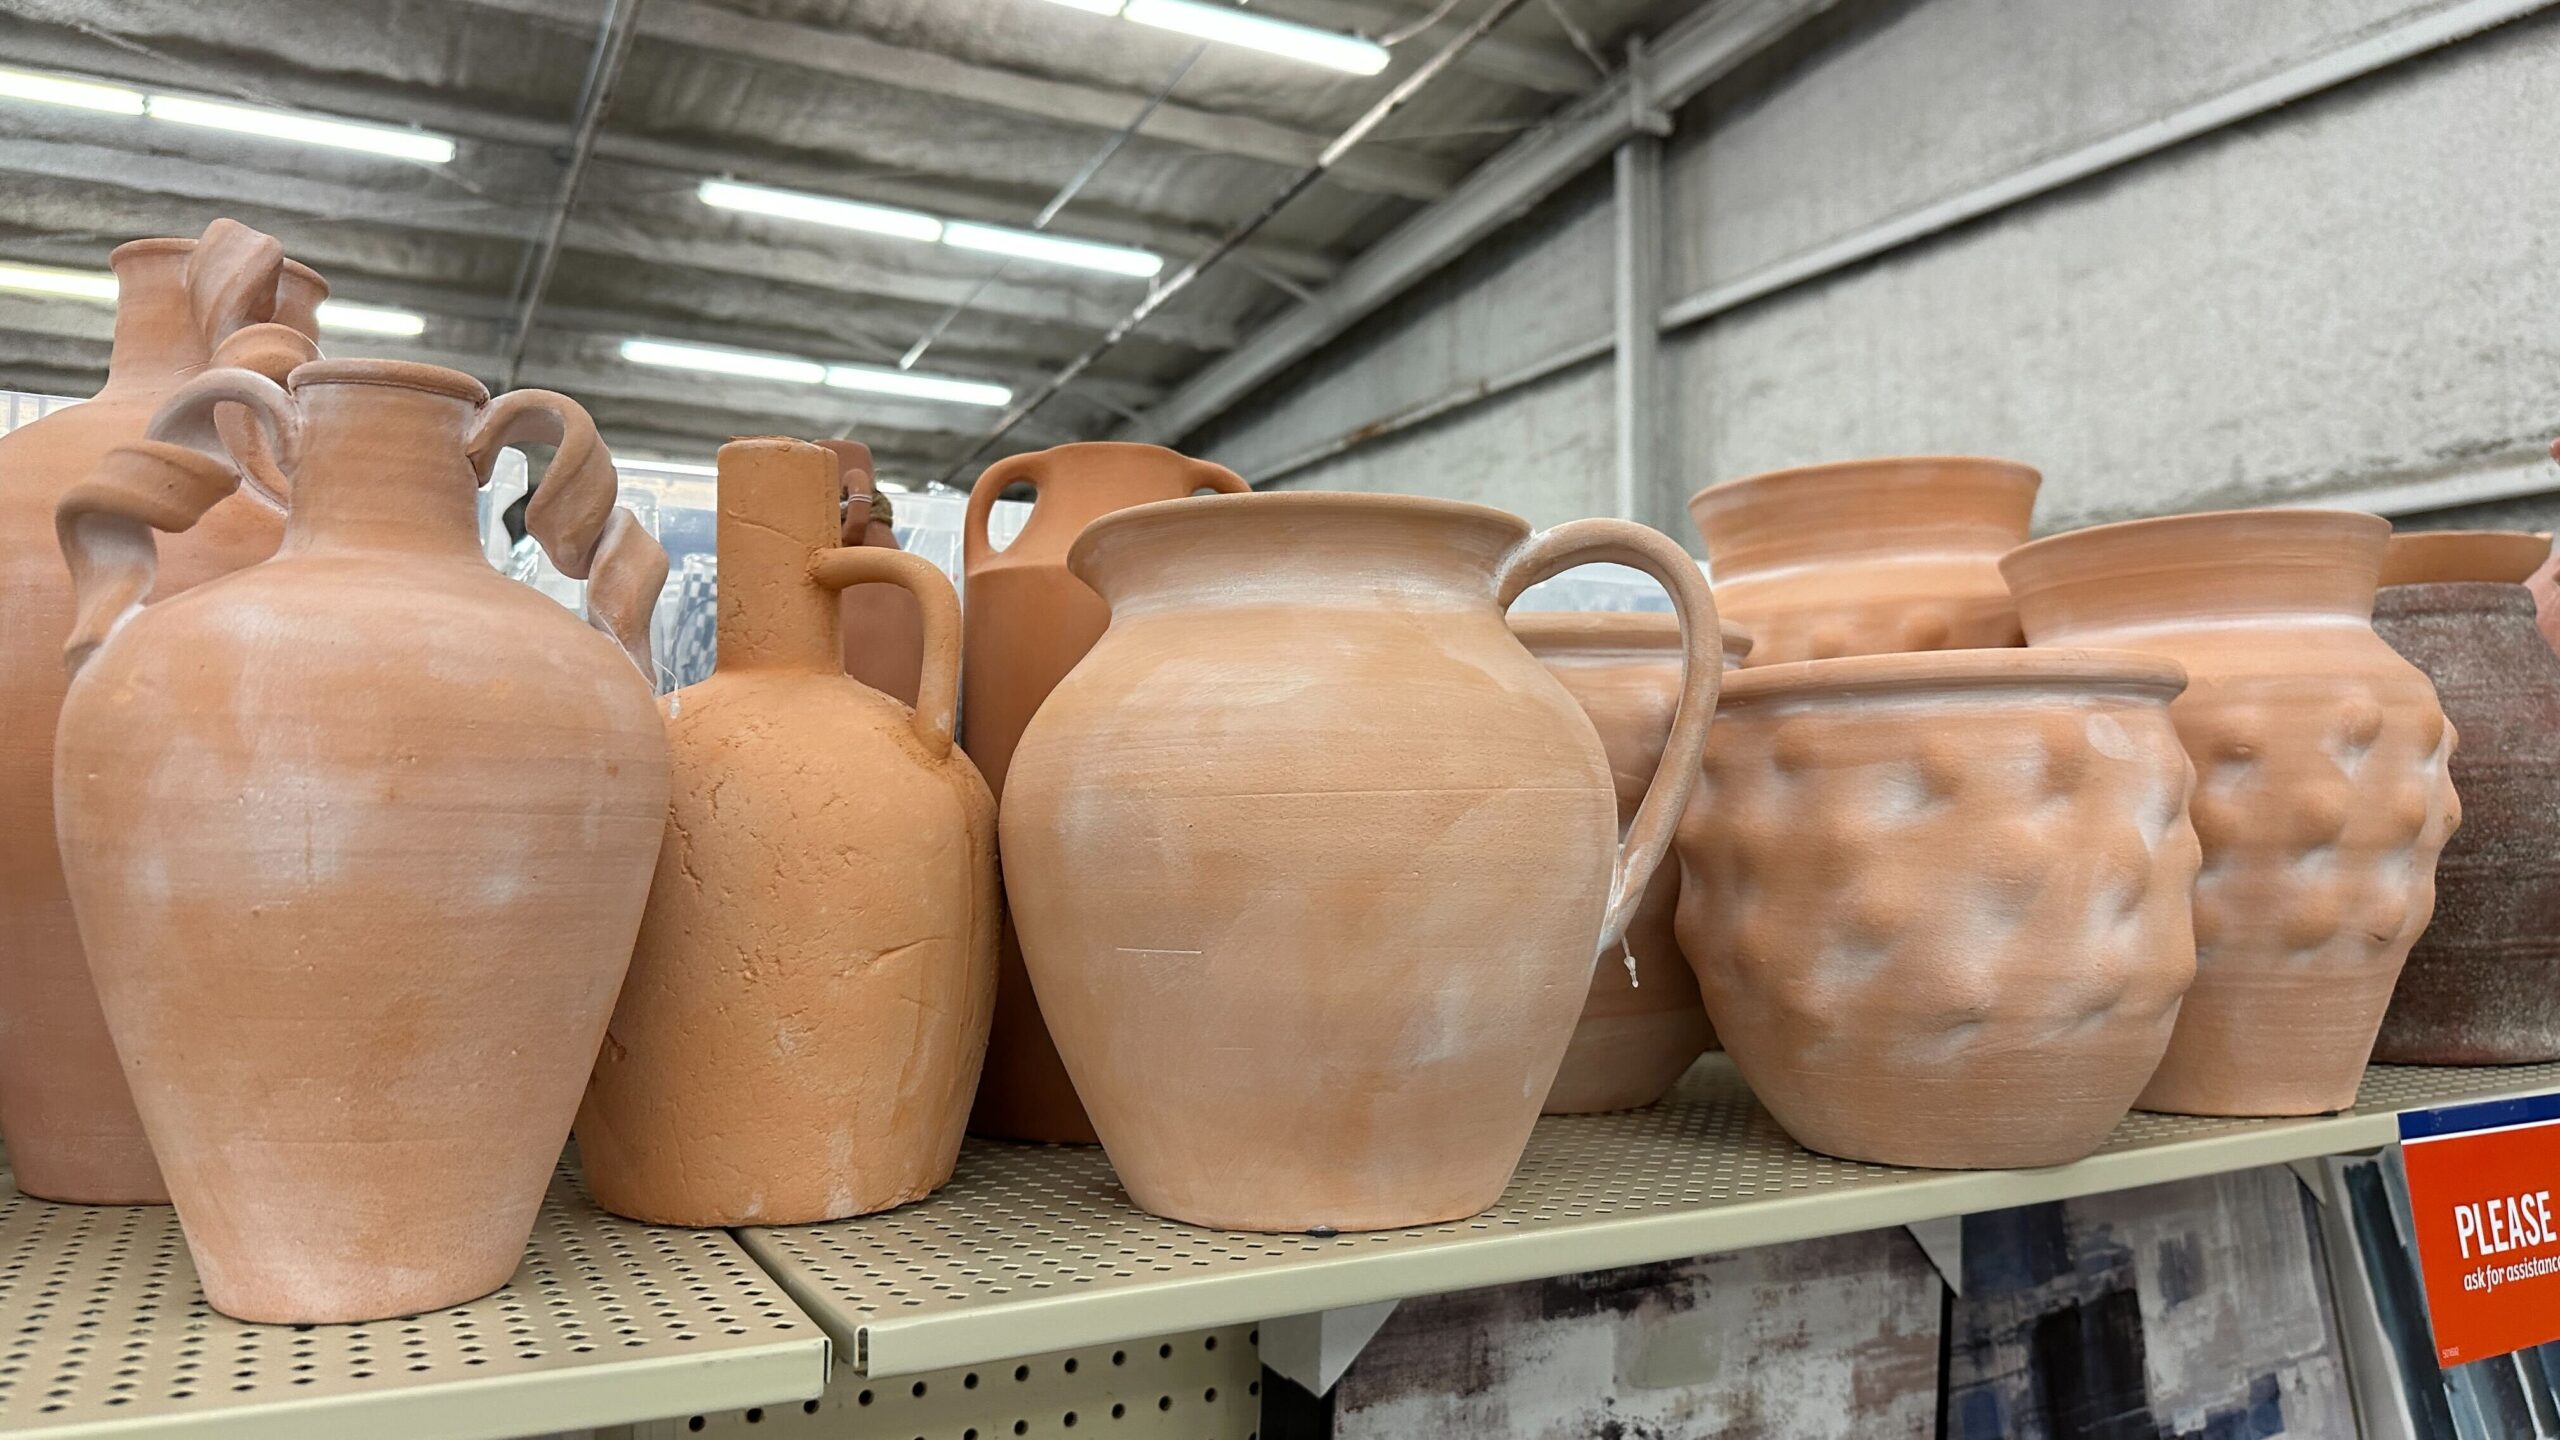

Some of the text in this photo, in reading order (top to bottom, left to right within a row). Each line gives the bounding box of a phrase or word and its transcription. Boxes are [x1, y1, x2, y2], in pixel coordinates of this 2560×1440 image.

[2454, 1191, 2557, 1259] PLEASE
[2463, 1267, 2486, 1291] ask
[2486, 1264, 2505, 1293] for
